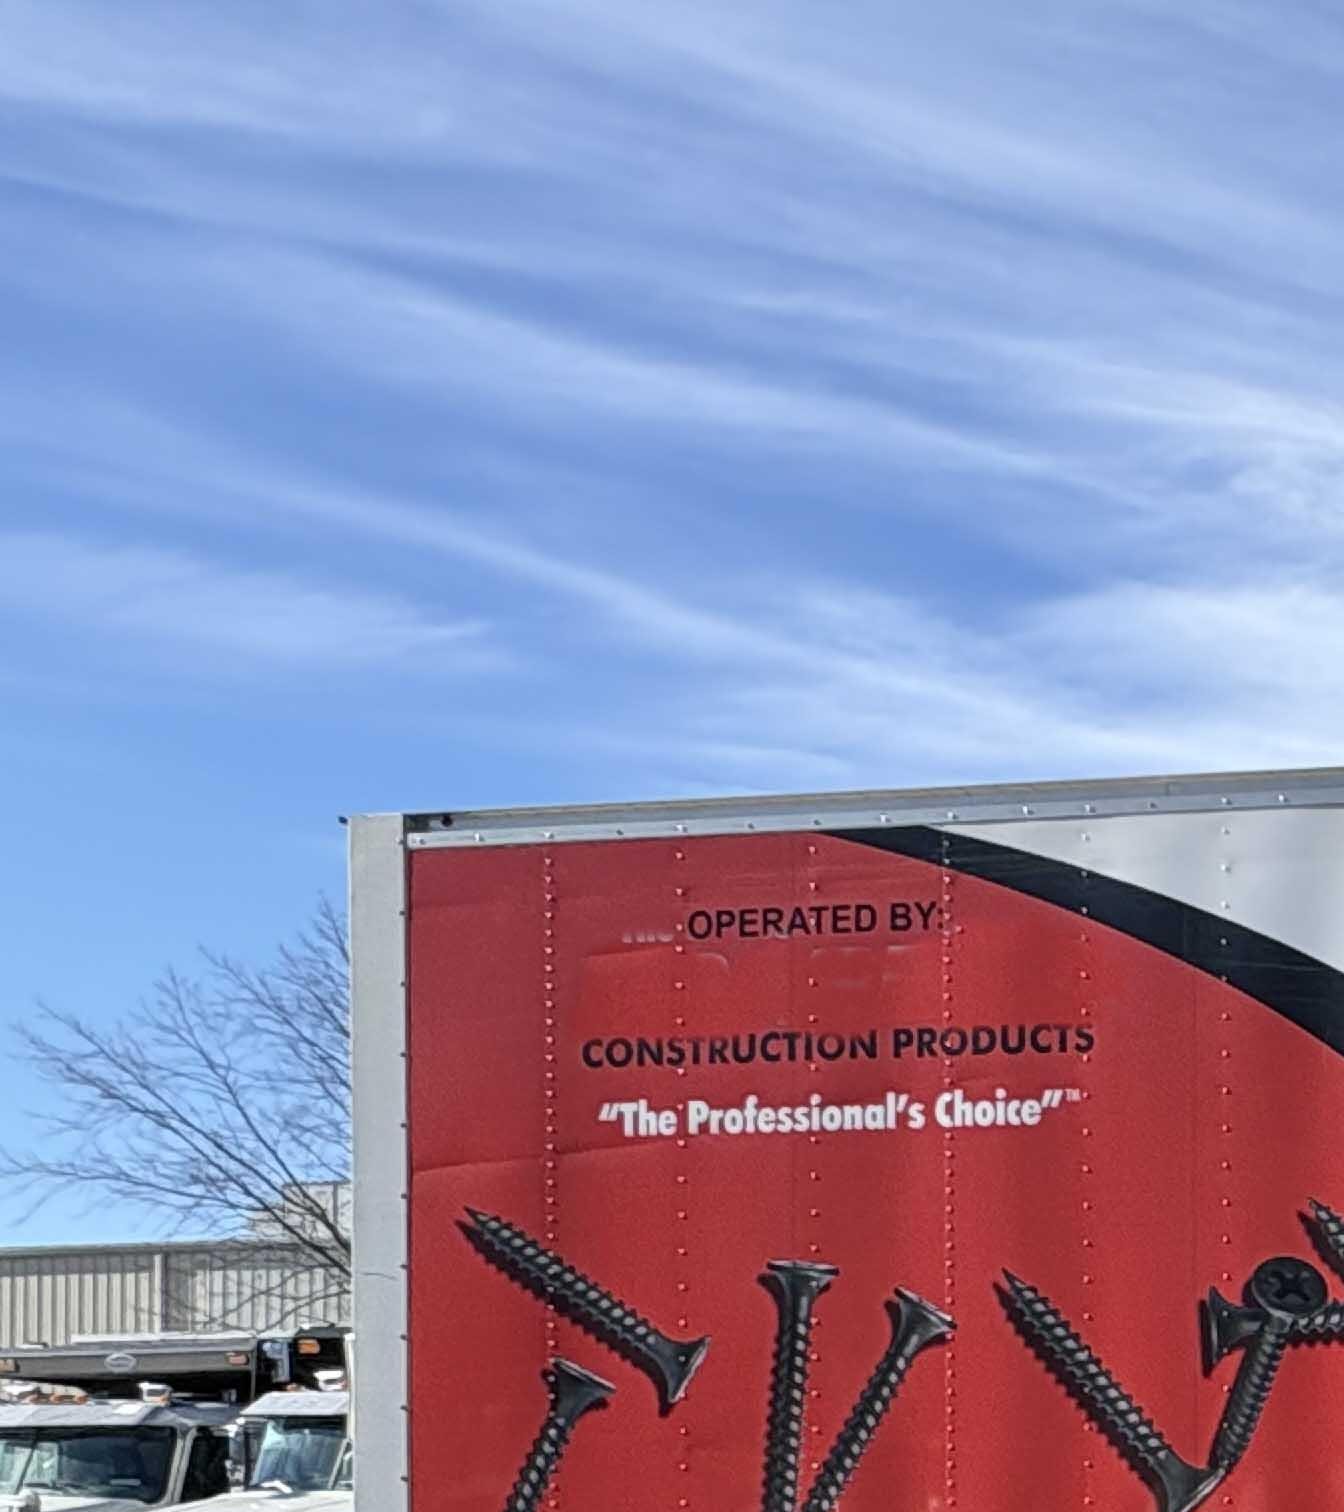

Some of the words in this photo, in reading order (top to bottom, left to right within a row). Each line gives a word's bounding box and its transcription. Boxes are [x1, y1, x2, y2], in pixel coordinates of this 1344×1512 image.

[687, 903, 878, 940] OPERATED
[582, 1029, 878, 1069] CONSTRUCTION
[892, 1022, 1095, 1060] PRODUCTS
[687, 1092, 926, 1136] Professional's
